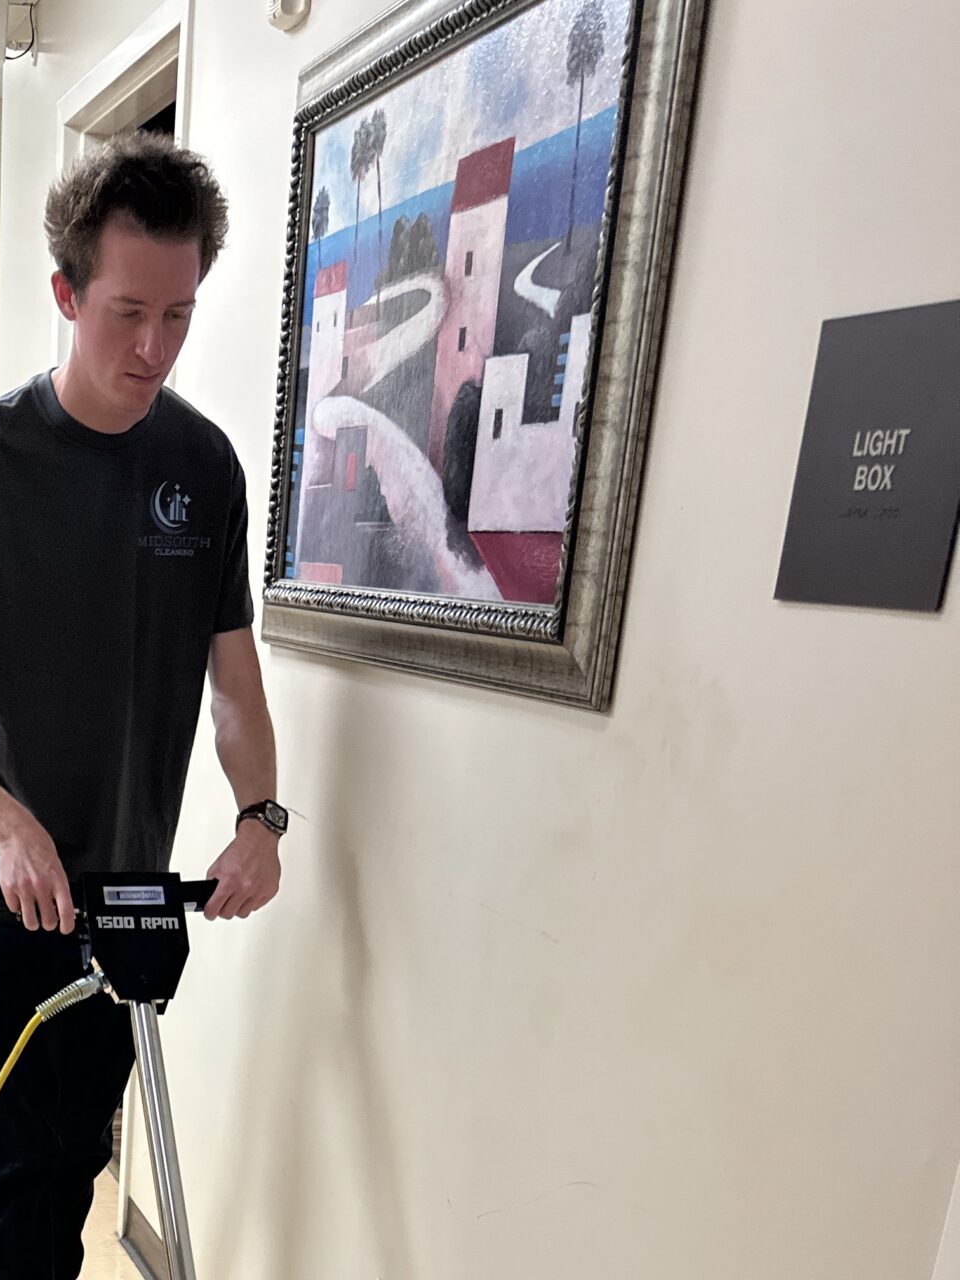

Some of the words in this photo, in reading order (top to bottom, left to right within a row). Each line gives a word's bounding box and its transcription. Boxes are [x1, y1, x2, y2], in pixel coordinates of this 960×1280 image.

[853, 428, 911, 457] LIGHT
[853, 464, 895, 491] BOX
[137, 535, 212, 549] MIDSOUTH
[154, 548, 195, 557] CLEANING
[95, 916, 135, 928] 1500
[140, 916, 180, 930] RPM
